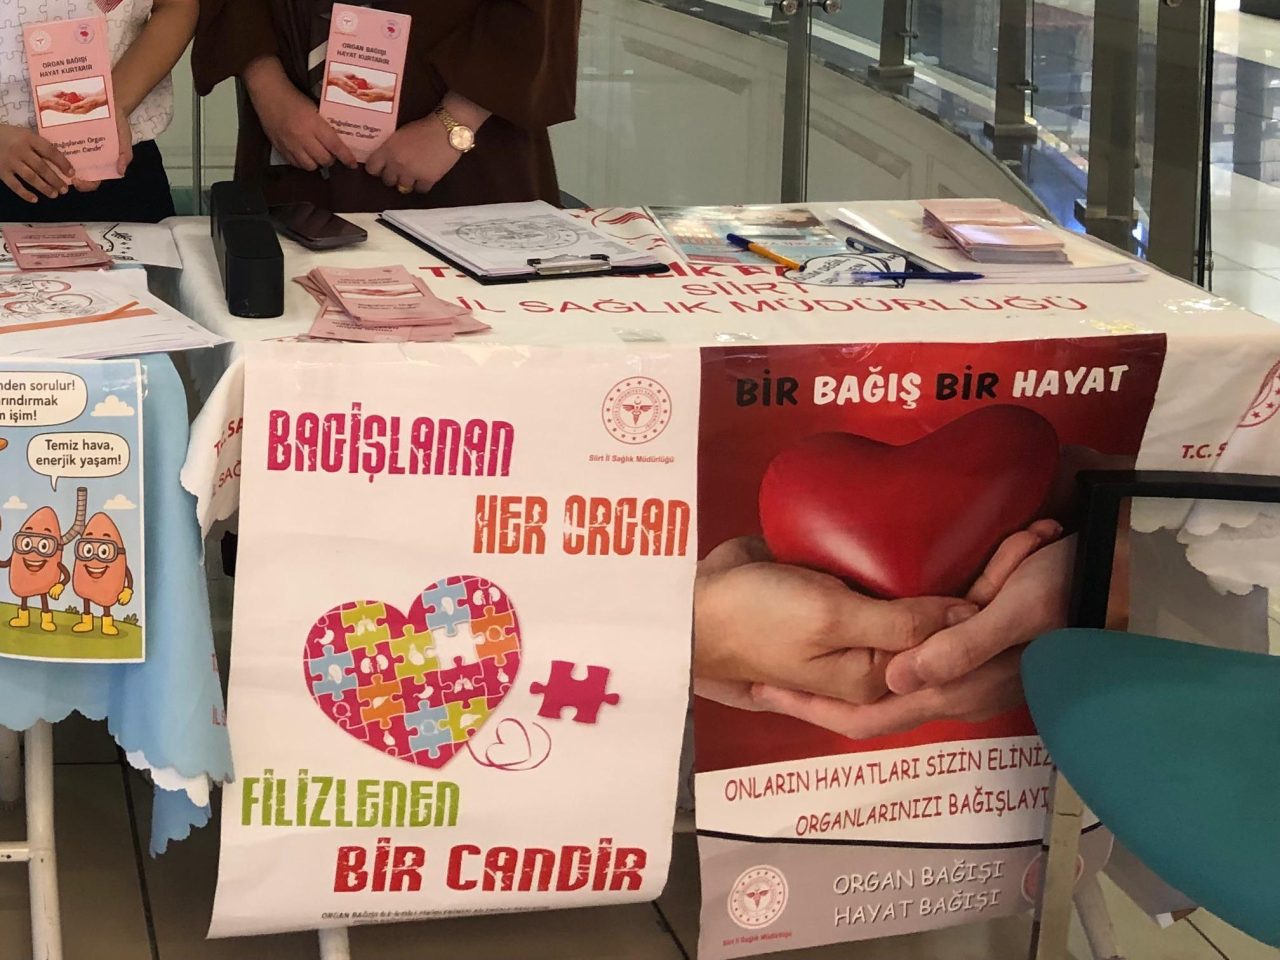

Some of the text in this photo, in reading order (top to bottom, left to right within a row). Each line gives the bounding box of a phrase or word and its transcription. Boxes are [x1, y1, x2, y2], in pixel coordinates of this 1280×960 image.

[39, 67, 60, 79] HAYAT
[42, 58, 65, 69] ORGAN
[518, 298, 723, 314] SAĞLIK
[728, 295, 1089, 313] MÜDÜRLÜĞÜ
[29, 378, 76, 391] sorulur!
[735, 363, 1129, 410] BİR BAĞIŞ BİR HAYAT
[9, 409, 38, 423] işim!
[44, 438, 115, 452] Temiz hava,
[1181, 443, 1212, 459] T.C.
[35, 455, 122, 469] enerjik yaşam!
[473, 494, 692, 557] HER ORGAN
[724, 769, 810, 802] ONLARIN
[815, 756, 920, 790] HAYATLARI
[926, 747, 982, 778] SİZİN
[240, 767, 460, 828] FİLİZLENEN
[795, 785, 1050, 837] ORGANLARINIZI BAĞIŞLAYI
[333, 836, 426, 893] BİR
[833, 858, 1005, 897] ORGAN BAĞIŞI
[834, 888, 1002, 928] HAYAT BAĞIŞI
